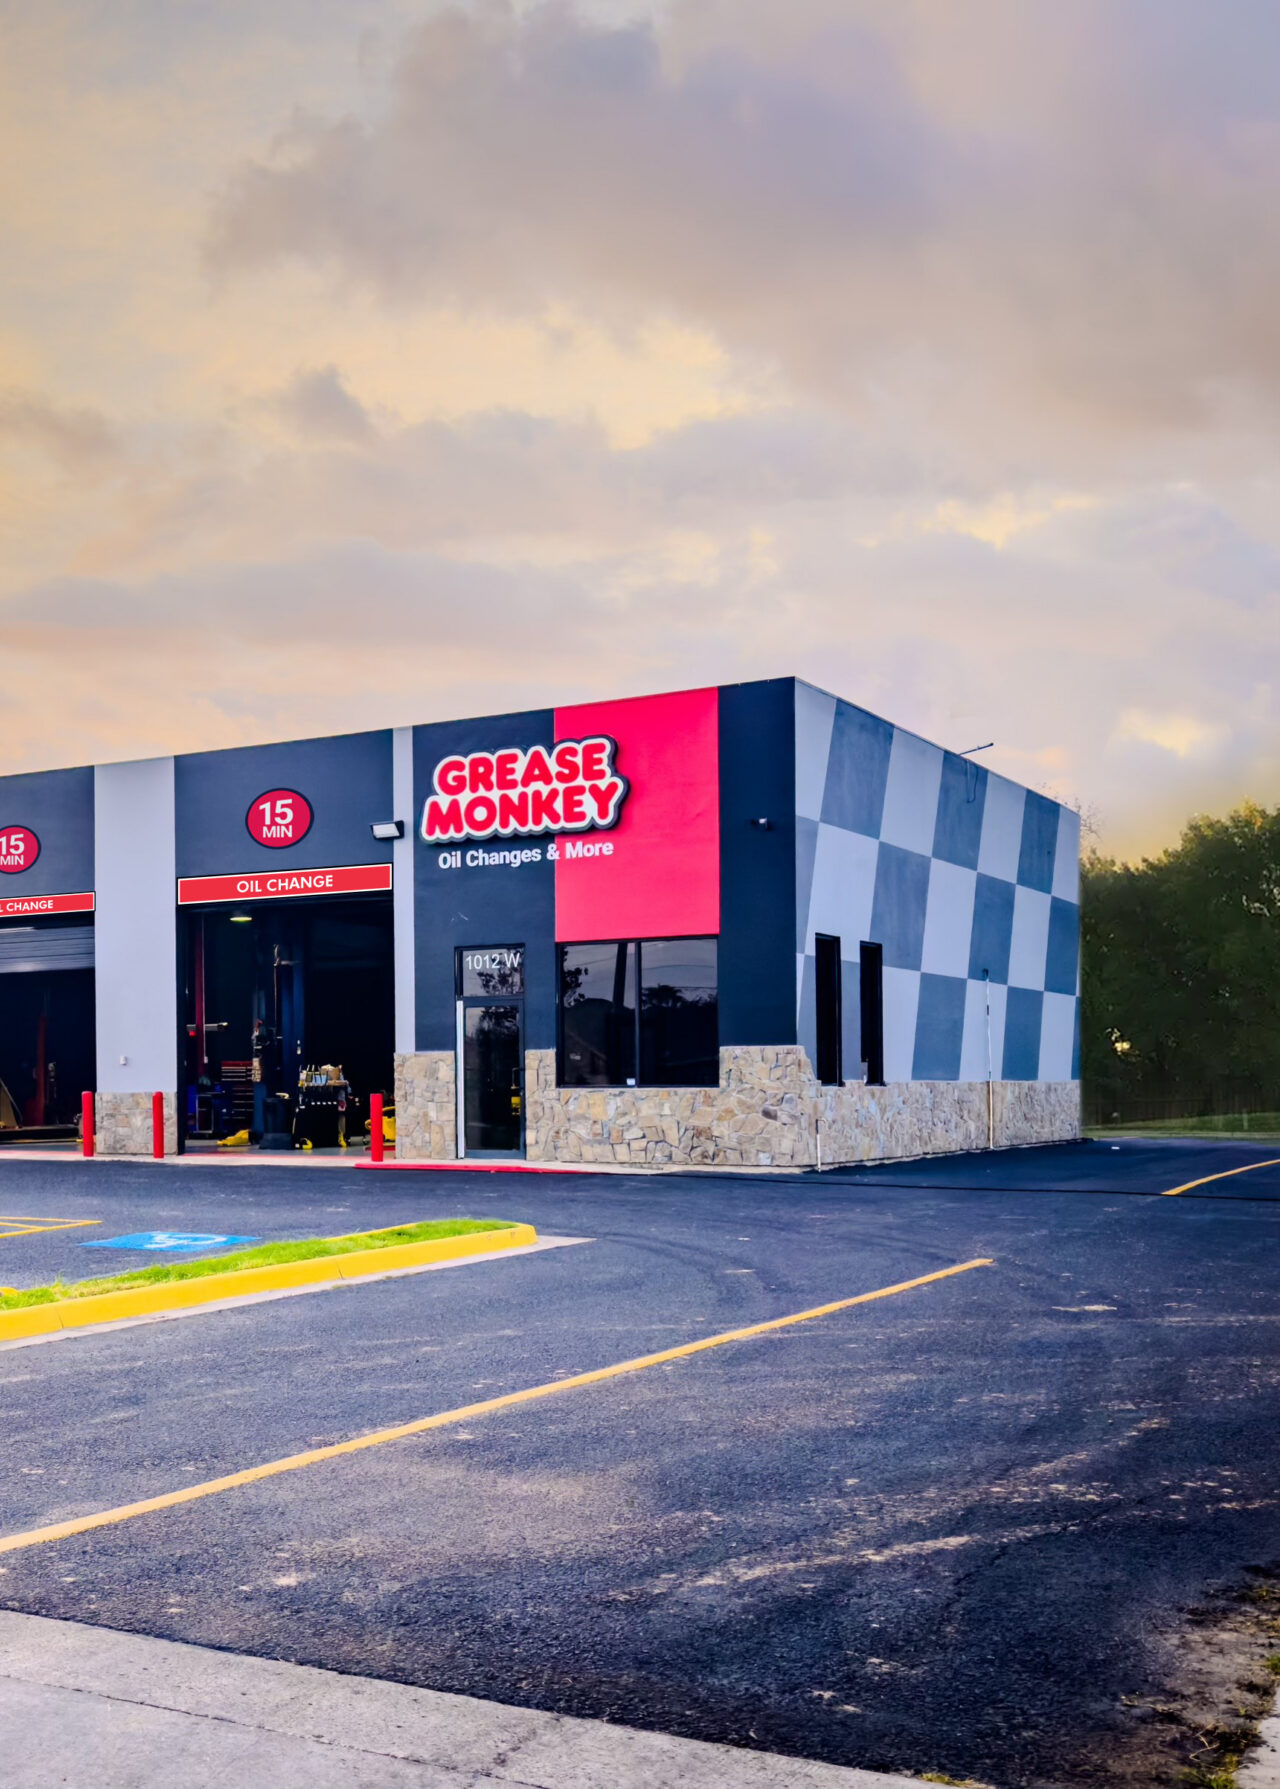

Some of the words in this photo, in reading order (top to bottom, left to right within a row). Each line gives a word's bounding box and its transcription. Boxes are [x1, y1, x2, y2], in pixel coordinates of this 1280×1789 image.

[437, 742, 607, 796] GREASE
[259, 798, 294, 825] 15
[425, 781, 618, 837] MONKEY
[262, 825, 293, 838] MIN
[0, 855, 24, 866] MIN
[438, 849, 461, 869] Oil
[466, 847, 542, 868] Changes
[546, 843, 561, 860] &
[565, 841, 614, 858] More
[236, 880, 262, 893] OIL
[266, 874, 334, 892] CHANGE
[6, 900, 54, 912] CHANGE
[465, 953, 500, 970] 1012
[502, 952, 521, 968] W
